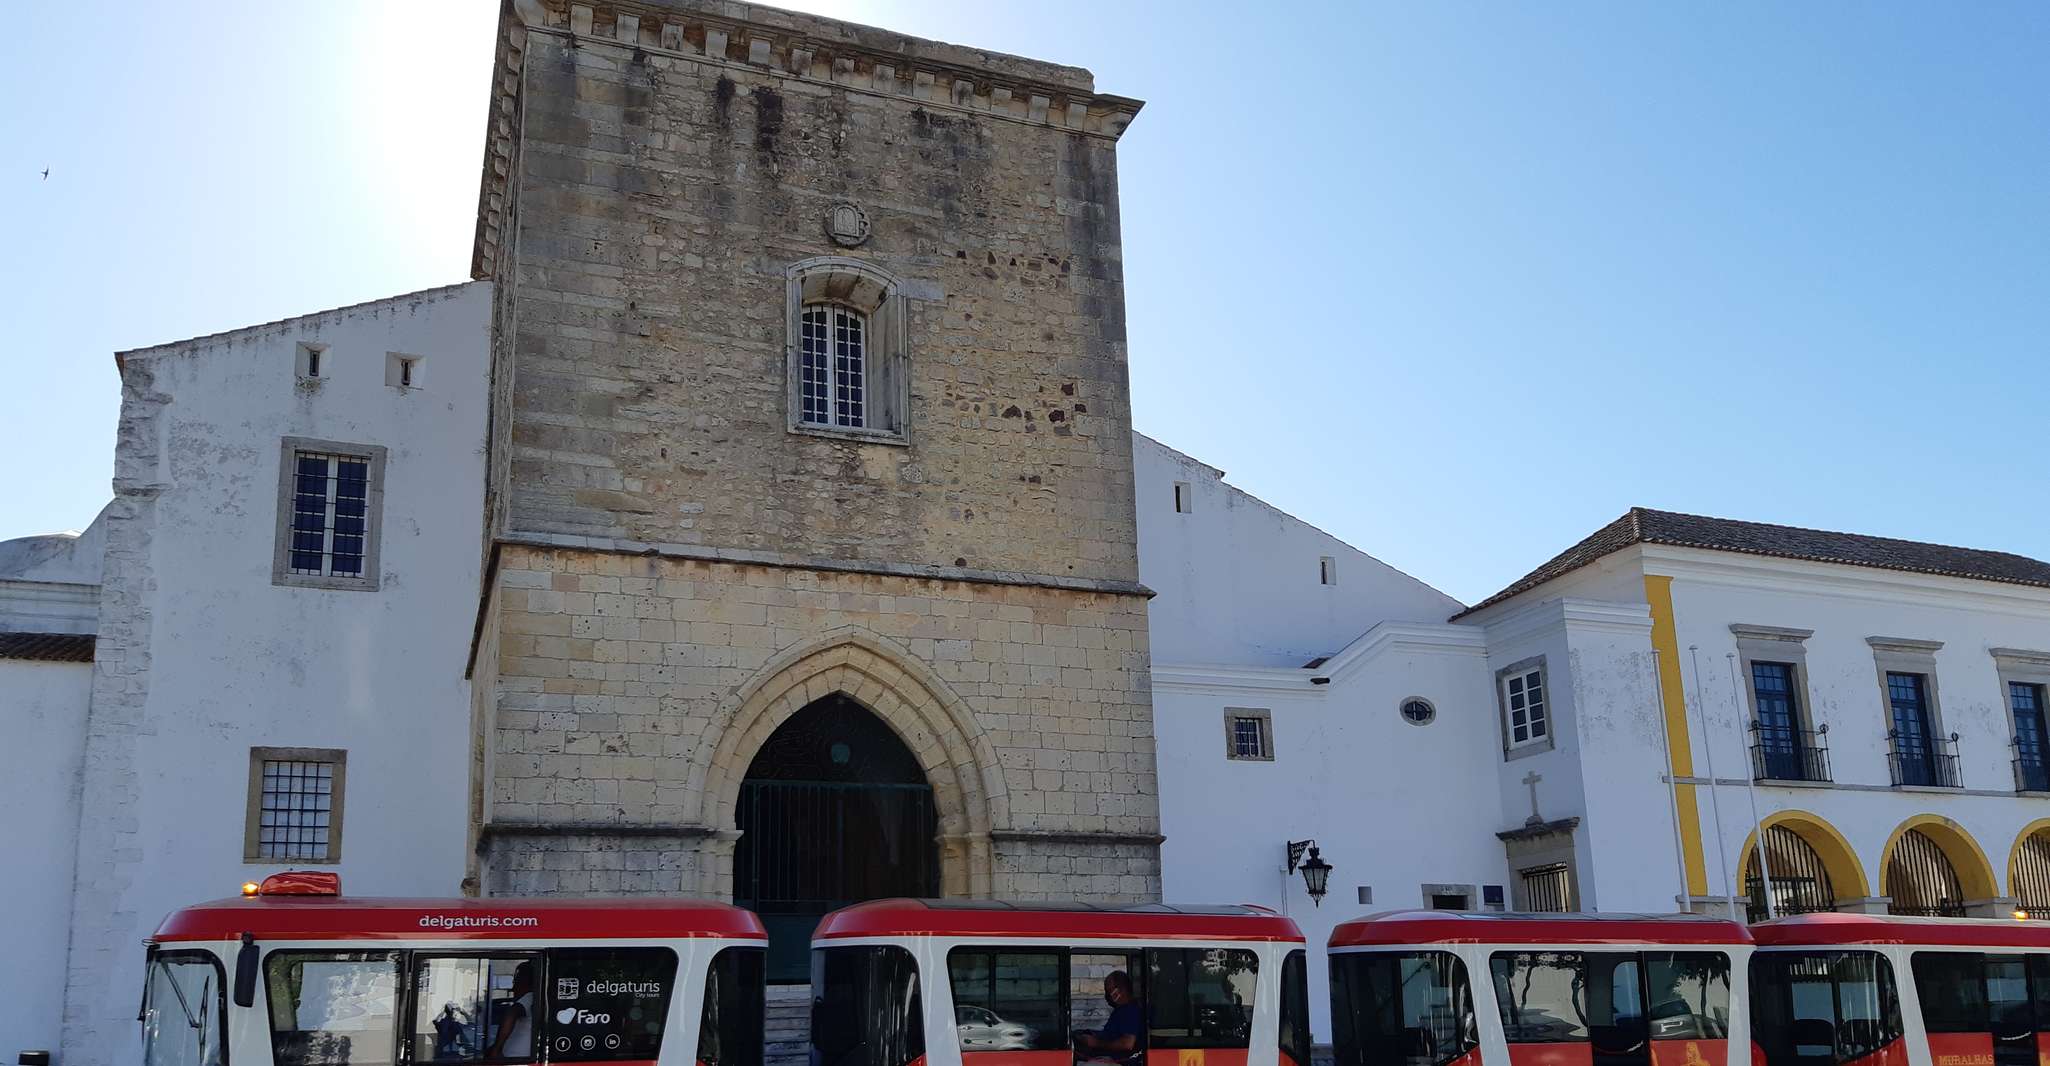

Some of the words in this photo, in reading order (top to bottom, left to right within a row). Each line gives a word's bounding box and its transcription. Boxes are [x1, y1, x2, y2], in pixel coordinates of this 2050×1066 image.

[419, 915, 538, 929] delgaturis.com
[586, 980, 660, 996] delgaturis
[577, 1009, 611, 1024] Faro
[1939, 1054, 1994, 1066] MURALHAS
